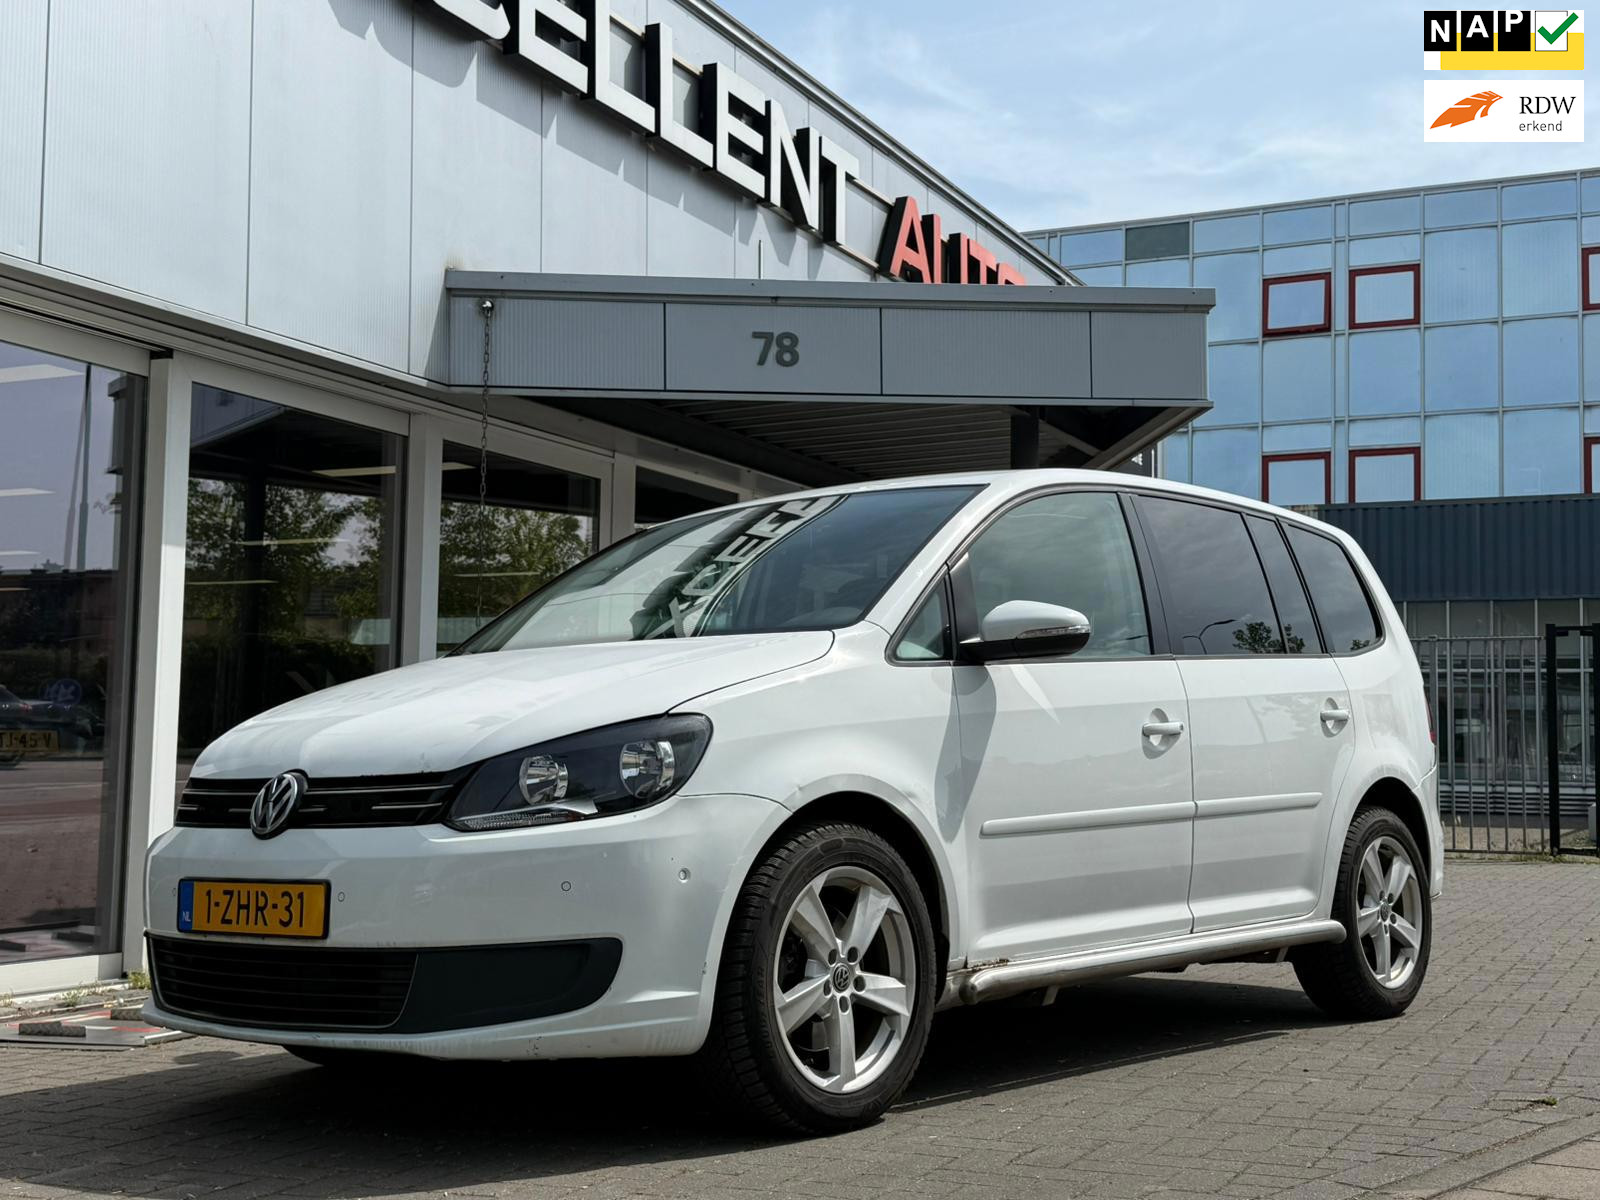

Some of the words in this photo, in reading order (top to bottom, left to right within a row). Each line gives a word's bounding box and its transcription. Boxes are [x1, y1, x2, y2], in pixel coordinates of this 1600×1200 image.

[432, 0, 860, 248] ELLENT
[889, 195, 1028, 286] AUT
[751, 331, 800, 367] 78
[182, 911, 191, 922] NL
[205, 889, 304, 928] 1-ZHR-31
